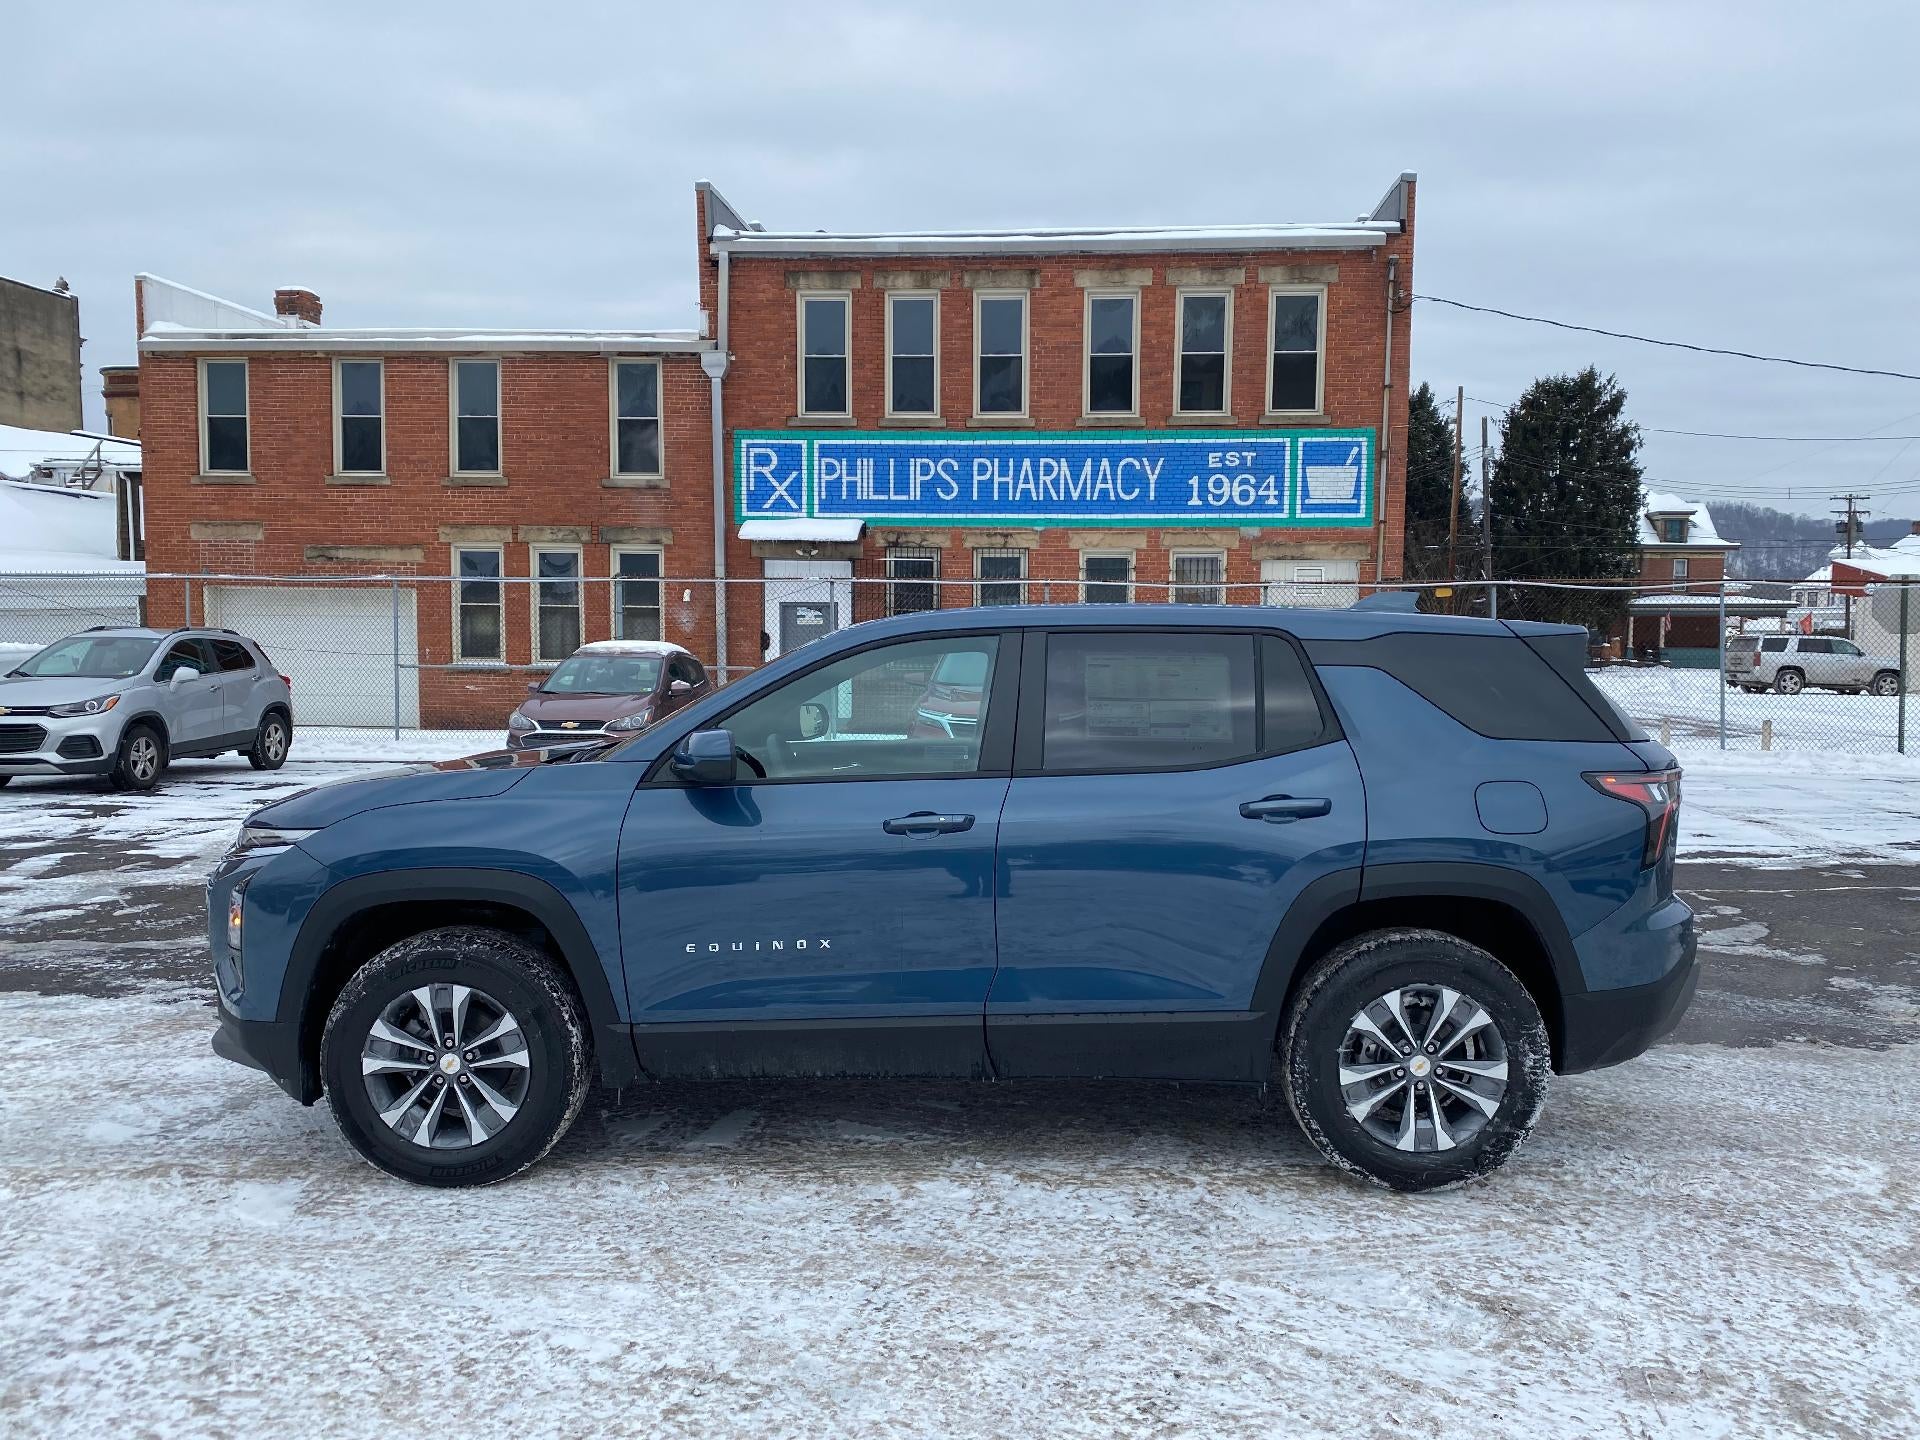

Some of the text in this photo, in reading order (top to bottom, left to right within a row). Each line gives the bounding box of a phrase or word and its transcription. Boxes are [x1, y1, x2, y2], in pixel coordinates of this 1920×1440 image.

[1208, 452, 1257, 468] EST
[820, 458, 1165, 501] PHILLIPS PHARMACY
[1187, 474, 1279, 506] 1964
[685, 939, 831, 953] EQUINOX
